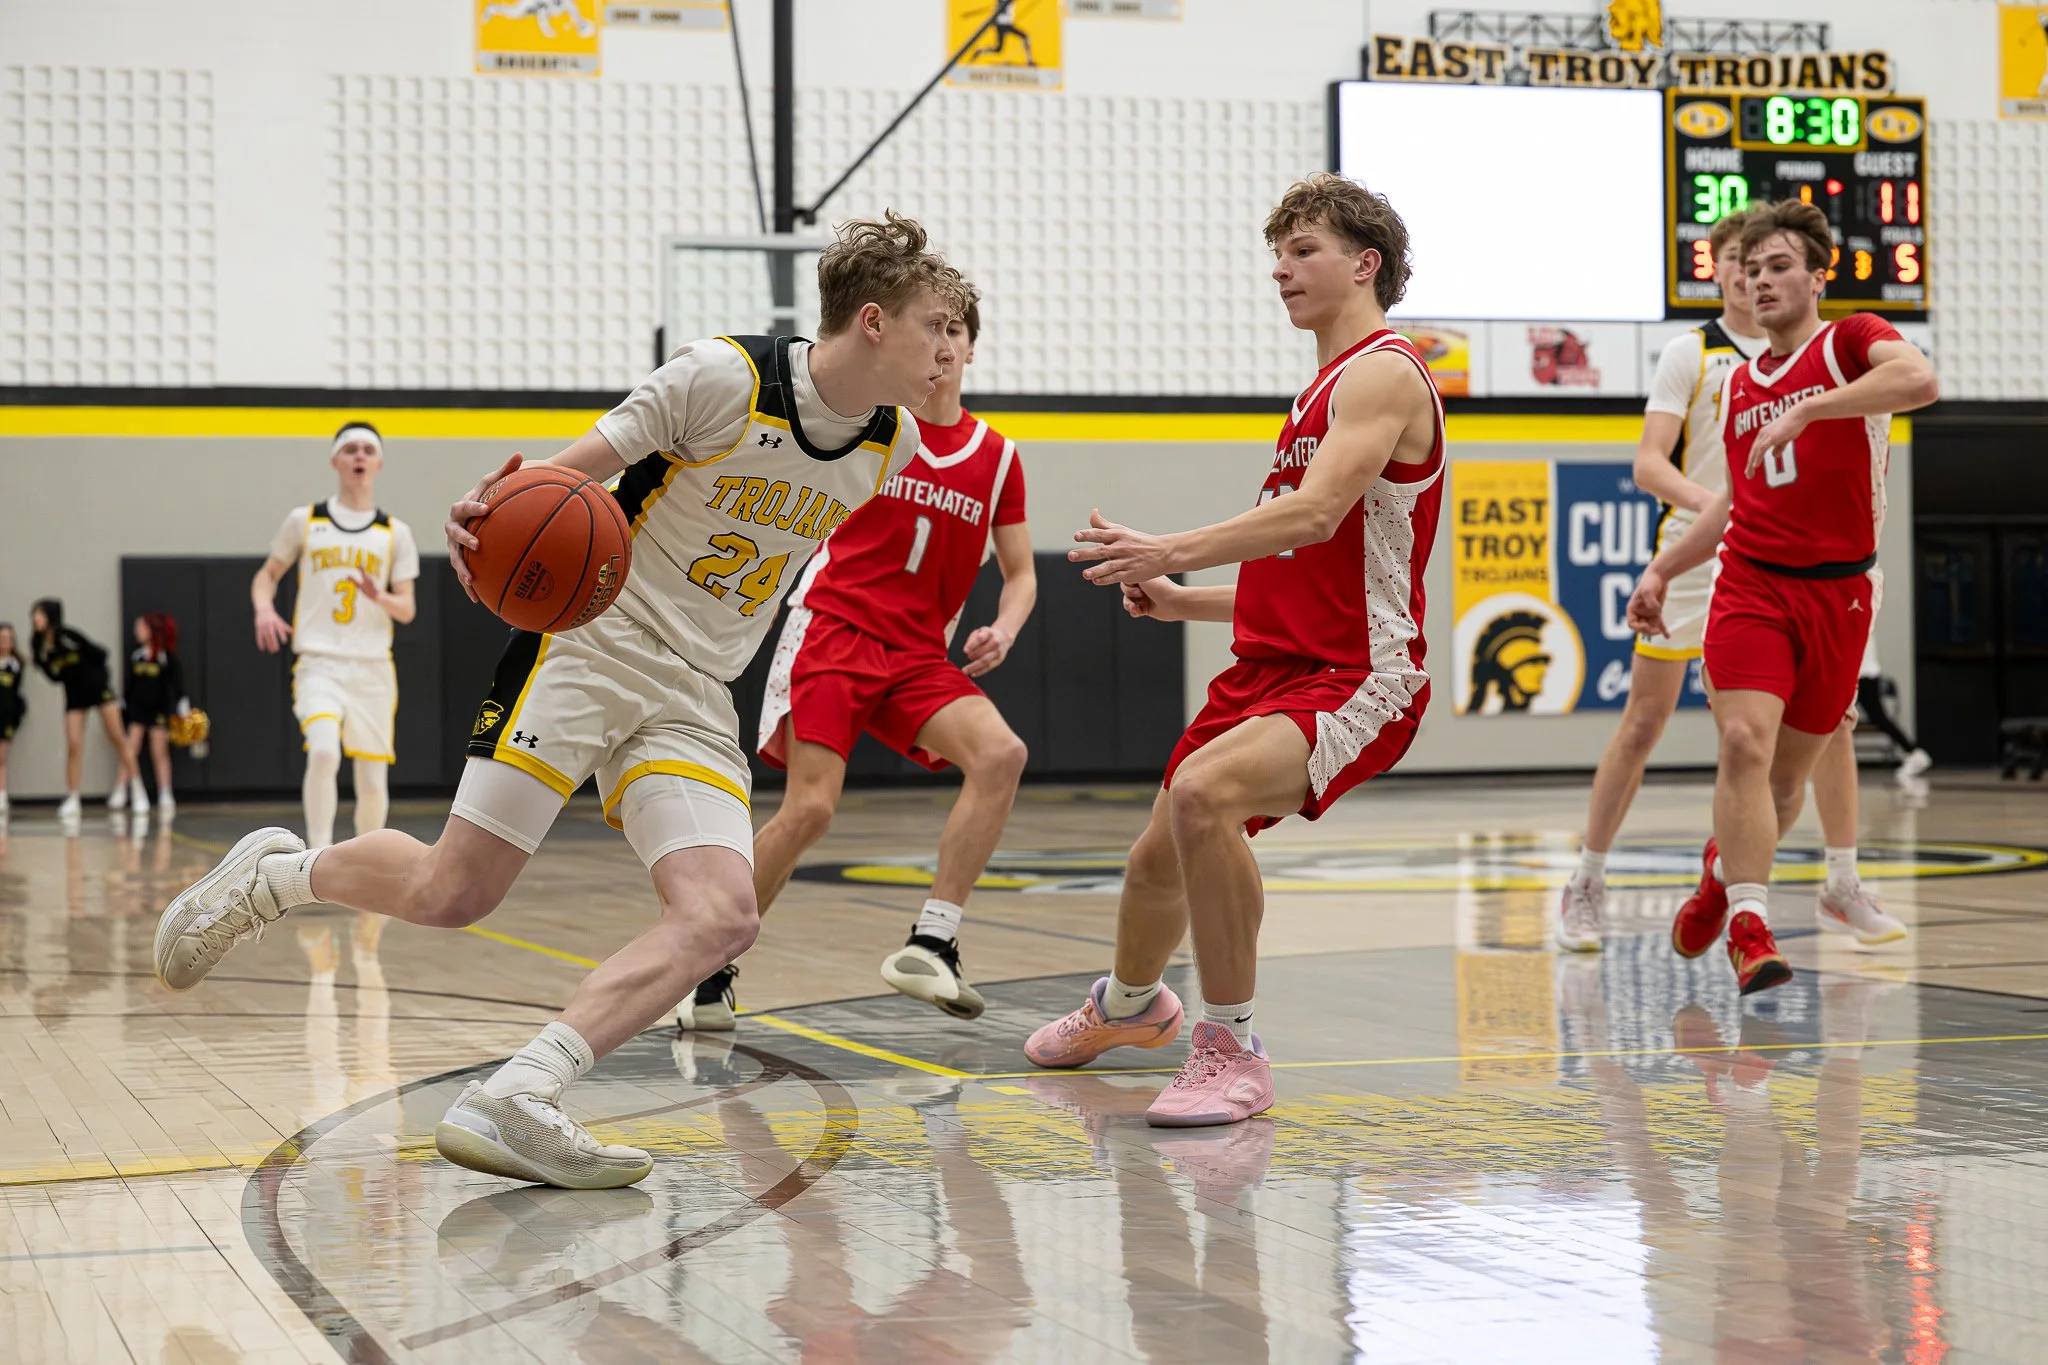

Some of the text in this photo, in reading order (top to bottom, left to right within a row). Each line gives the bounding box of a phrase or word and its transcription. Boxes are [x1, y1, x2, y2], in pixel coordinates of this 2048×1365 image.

[1373, 35, 1889, 92] EAST TROY TROJANS
[1766, 96, 1859, 146] 8:30
[1685, 148, 1743, 172] HOME
[1853, 152, 1917, 176] GUEST
[1694, 174, 1748, 223] 30
[1880, 181, 1920, 224] 11
[1692, 239, 1715, 279] 3
[1895, 242, 1920, 283] 5
[878, 475, 984, 527] HITEWATER
[1461, 498, 1547, 525] EAST
[904, 514, 932, 575] 1
[1459, 533, 1547, 559] TROY
[1568, 501, 1653, 567] CUL
[686, 531, 797, 617] 24
[332, 580, 358, 625] 3
